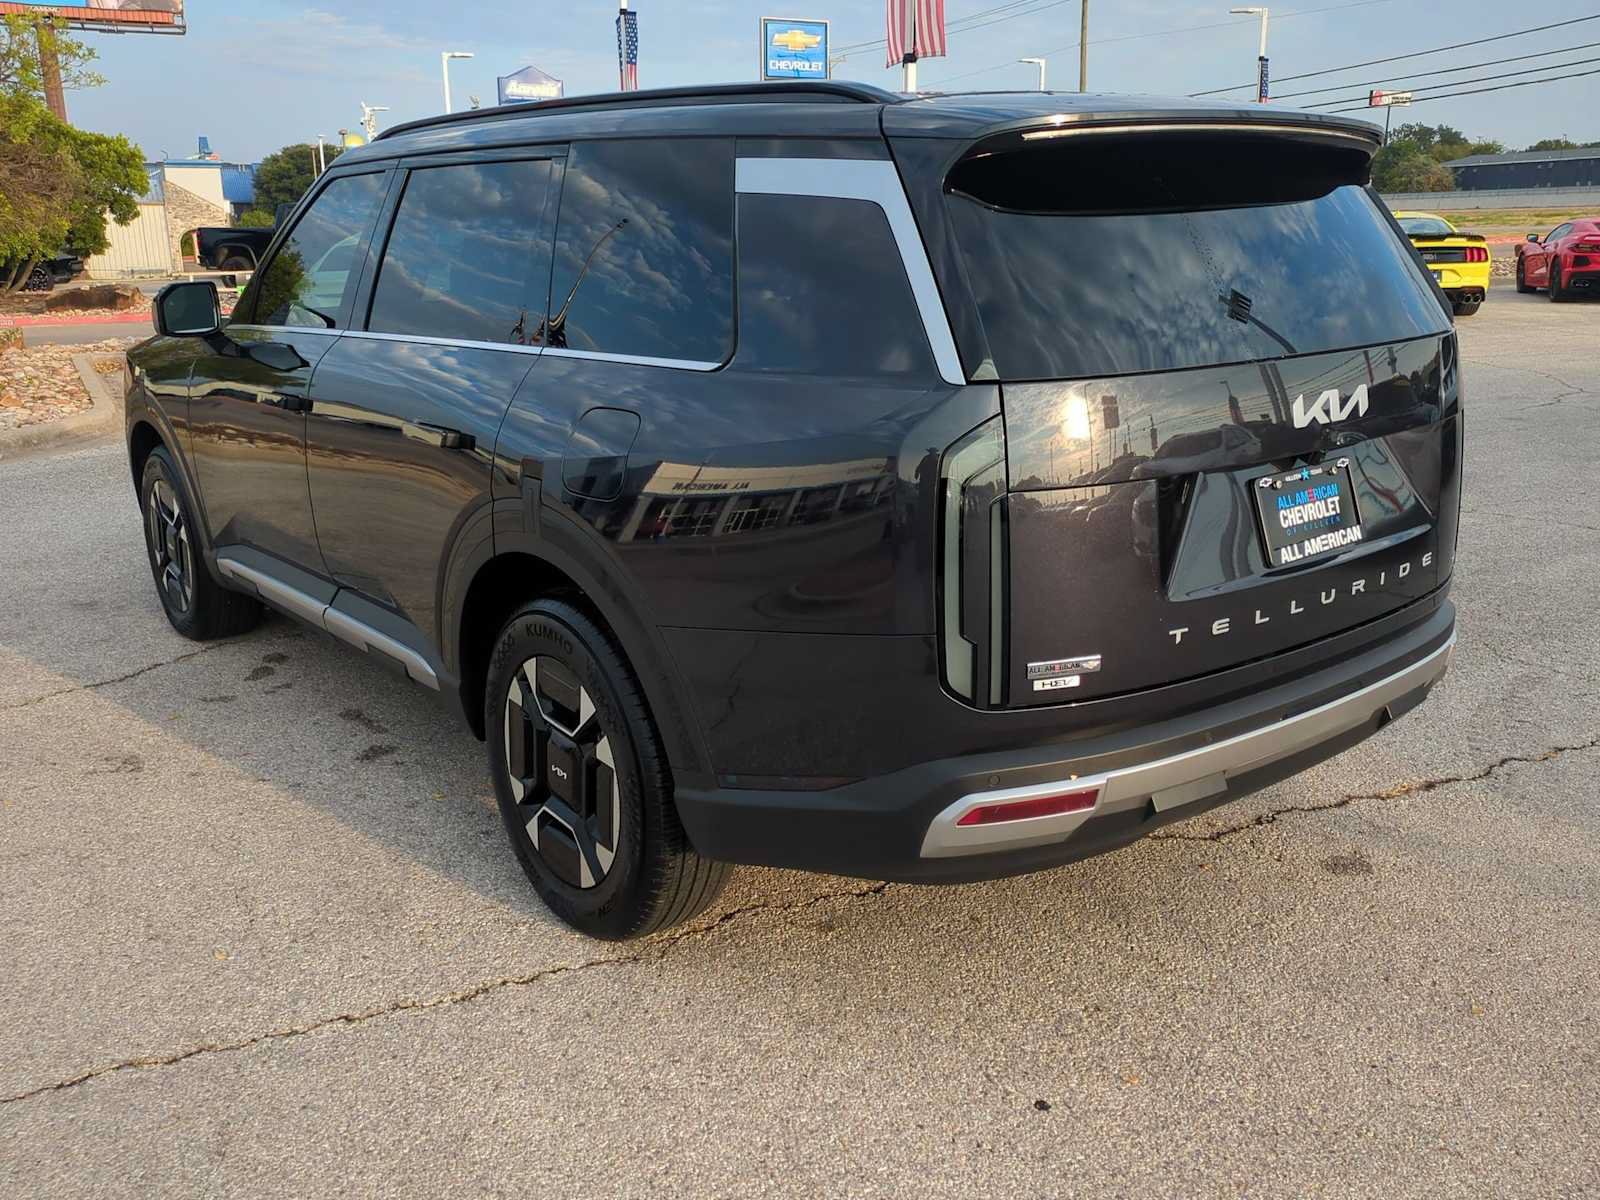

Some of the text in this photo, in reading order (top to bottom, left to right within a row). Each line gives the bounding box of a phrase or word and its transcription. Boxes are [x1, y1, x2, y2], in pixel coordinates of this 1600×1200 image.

[769, 60, 823, 71] CHEVROLET
[1277, 483, 1339, 510] ALL AMERICAN
[1280, 496, 1341, 529] CHEVROLET
[1280, 525, 1362, 564] ALL AMERICAN
[1168, 552, 1433, 645] TELLURIDE
